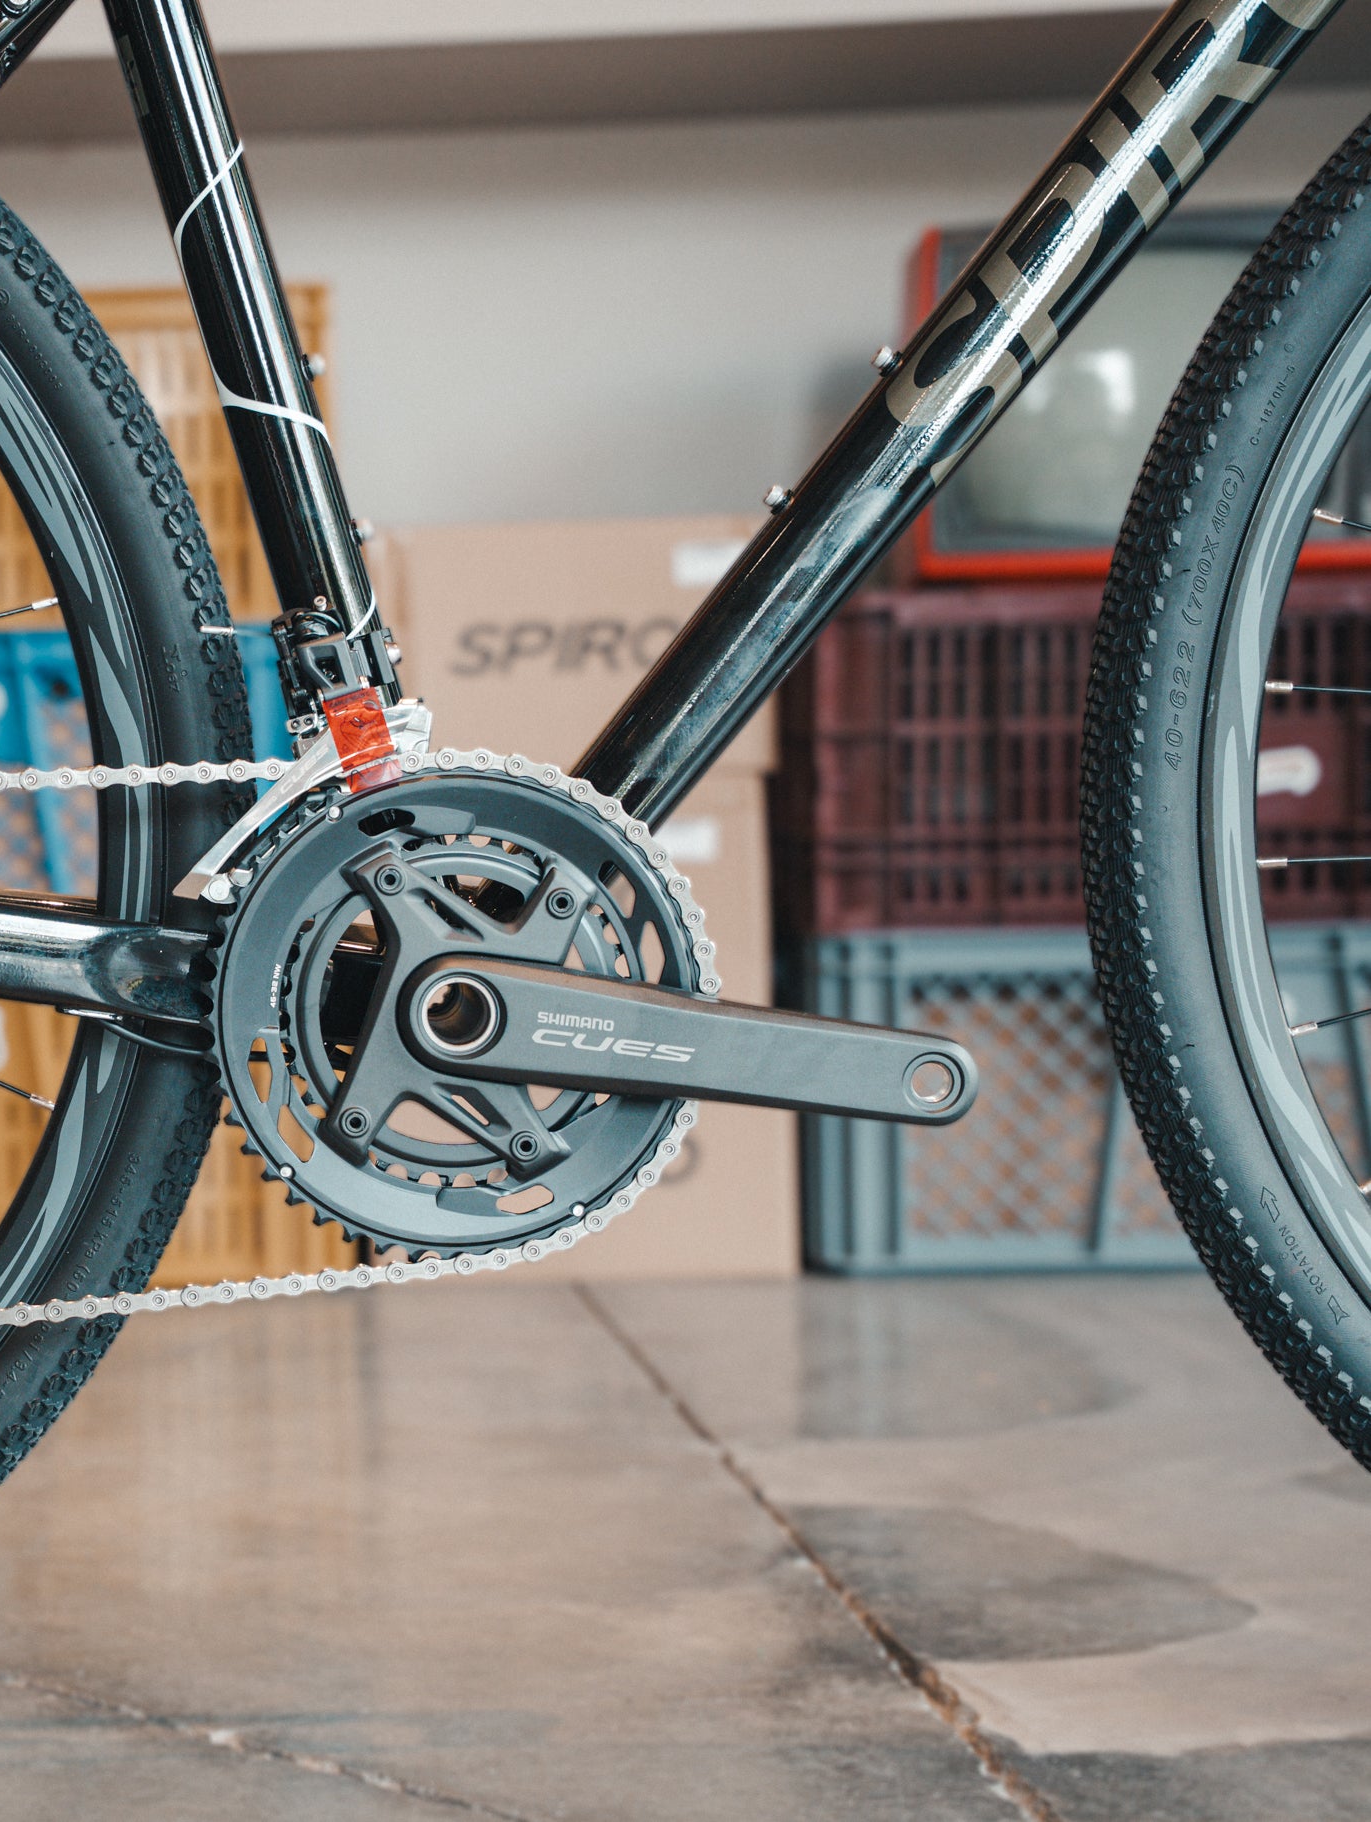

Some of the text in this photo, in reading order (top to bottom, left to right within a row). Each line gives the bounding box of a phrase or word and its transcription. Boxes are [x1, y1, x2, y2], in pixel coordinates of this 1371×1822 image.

[885, 0, 1334, 488] SPIR
[1165, 640, 1196, 771] 40-622
[531, 1028, 696, 1063] CUES
[537, 1011, 615, 1032] SHIMANO
[1278, 1223, 1329, 1296] ROTATION
